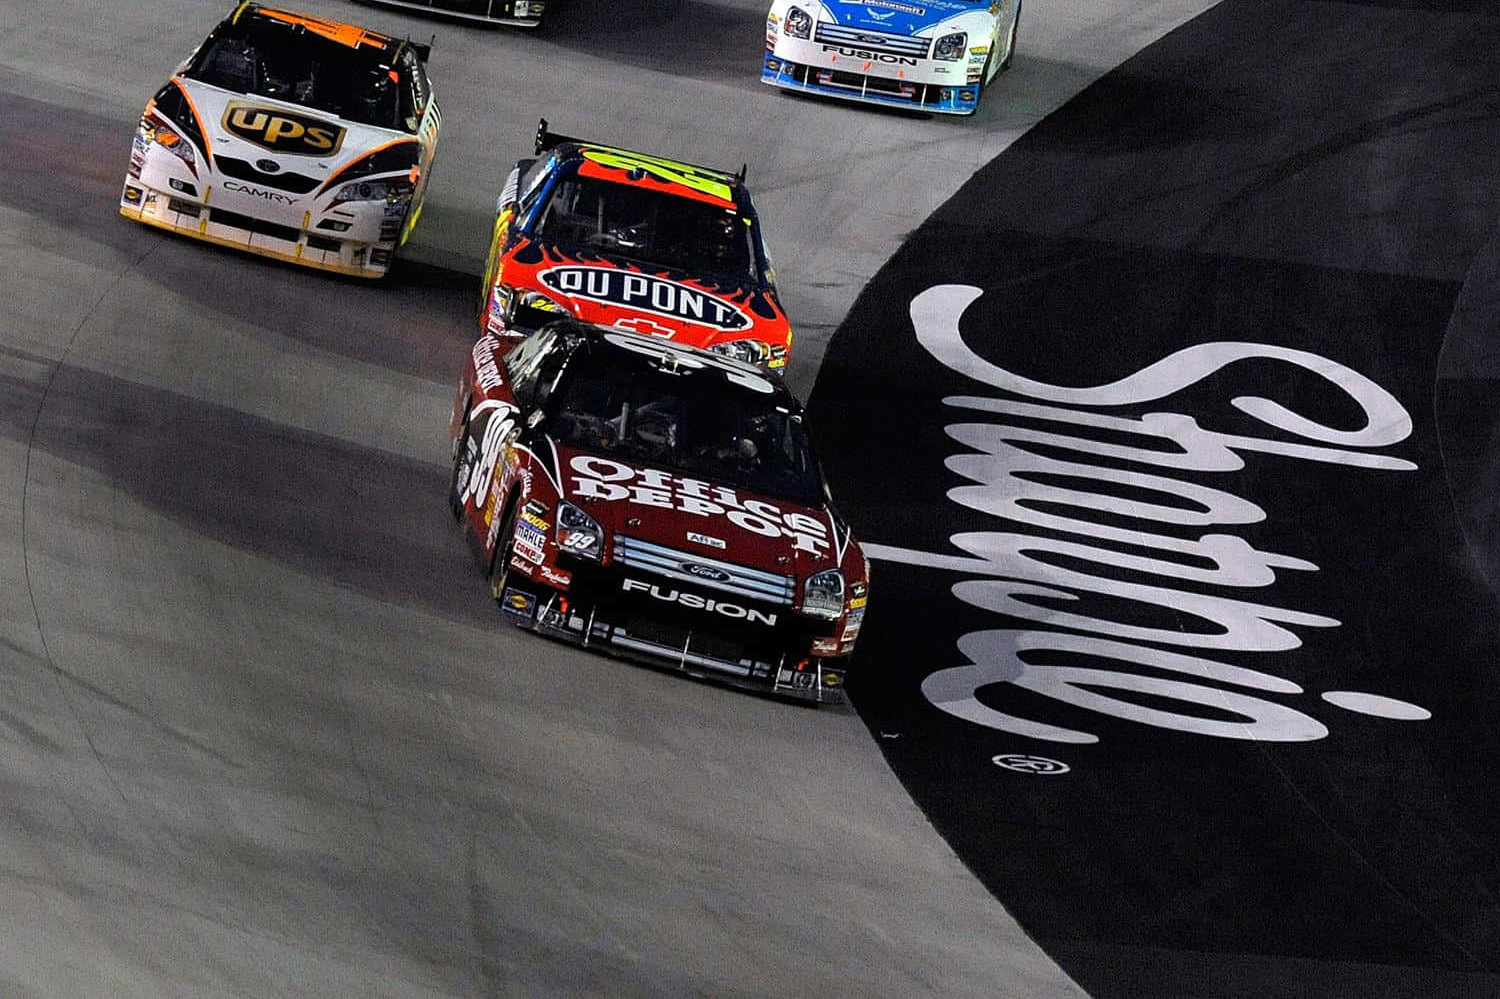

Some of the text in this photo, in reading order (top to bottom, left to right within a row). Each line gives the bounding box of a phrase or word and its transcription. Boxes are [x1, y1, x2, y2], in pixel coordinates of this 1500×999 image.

[822, 44, 918, 67] FUSION
[231, 107, 335, 150] ups
[223, 181, 300, 206] CAMRY
[623, 275, 732, 323] PONT
[570, 475, 831, 557] DEPOT
[866, 283, 1432, 745] Sharpie
[517, 525, 546, 550] MAHLE
[563, 531, 597, 550] 99
[690, 563, 723, 579] Ford
[621, 578, 778, 627] FUSION
